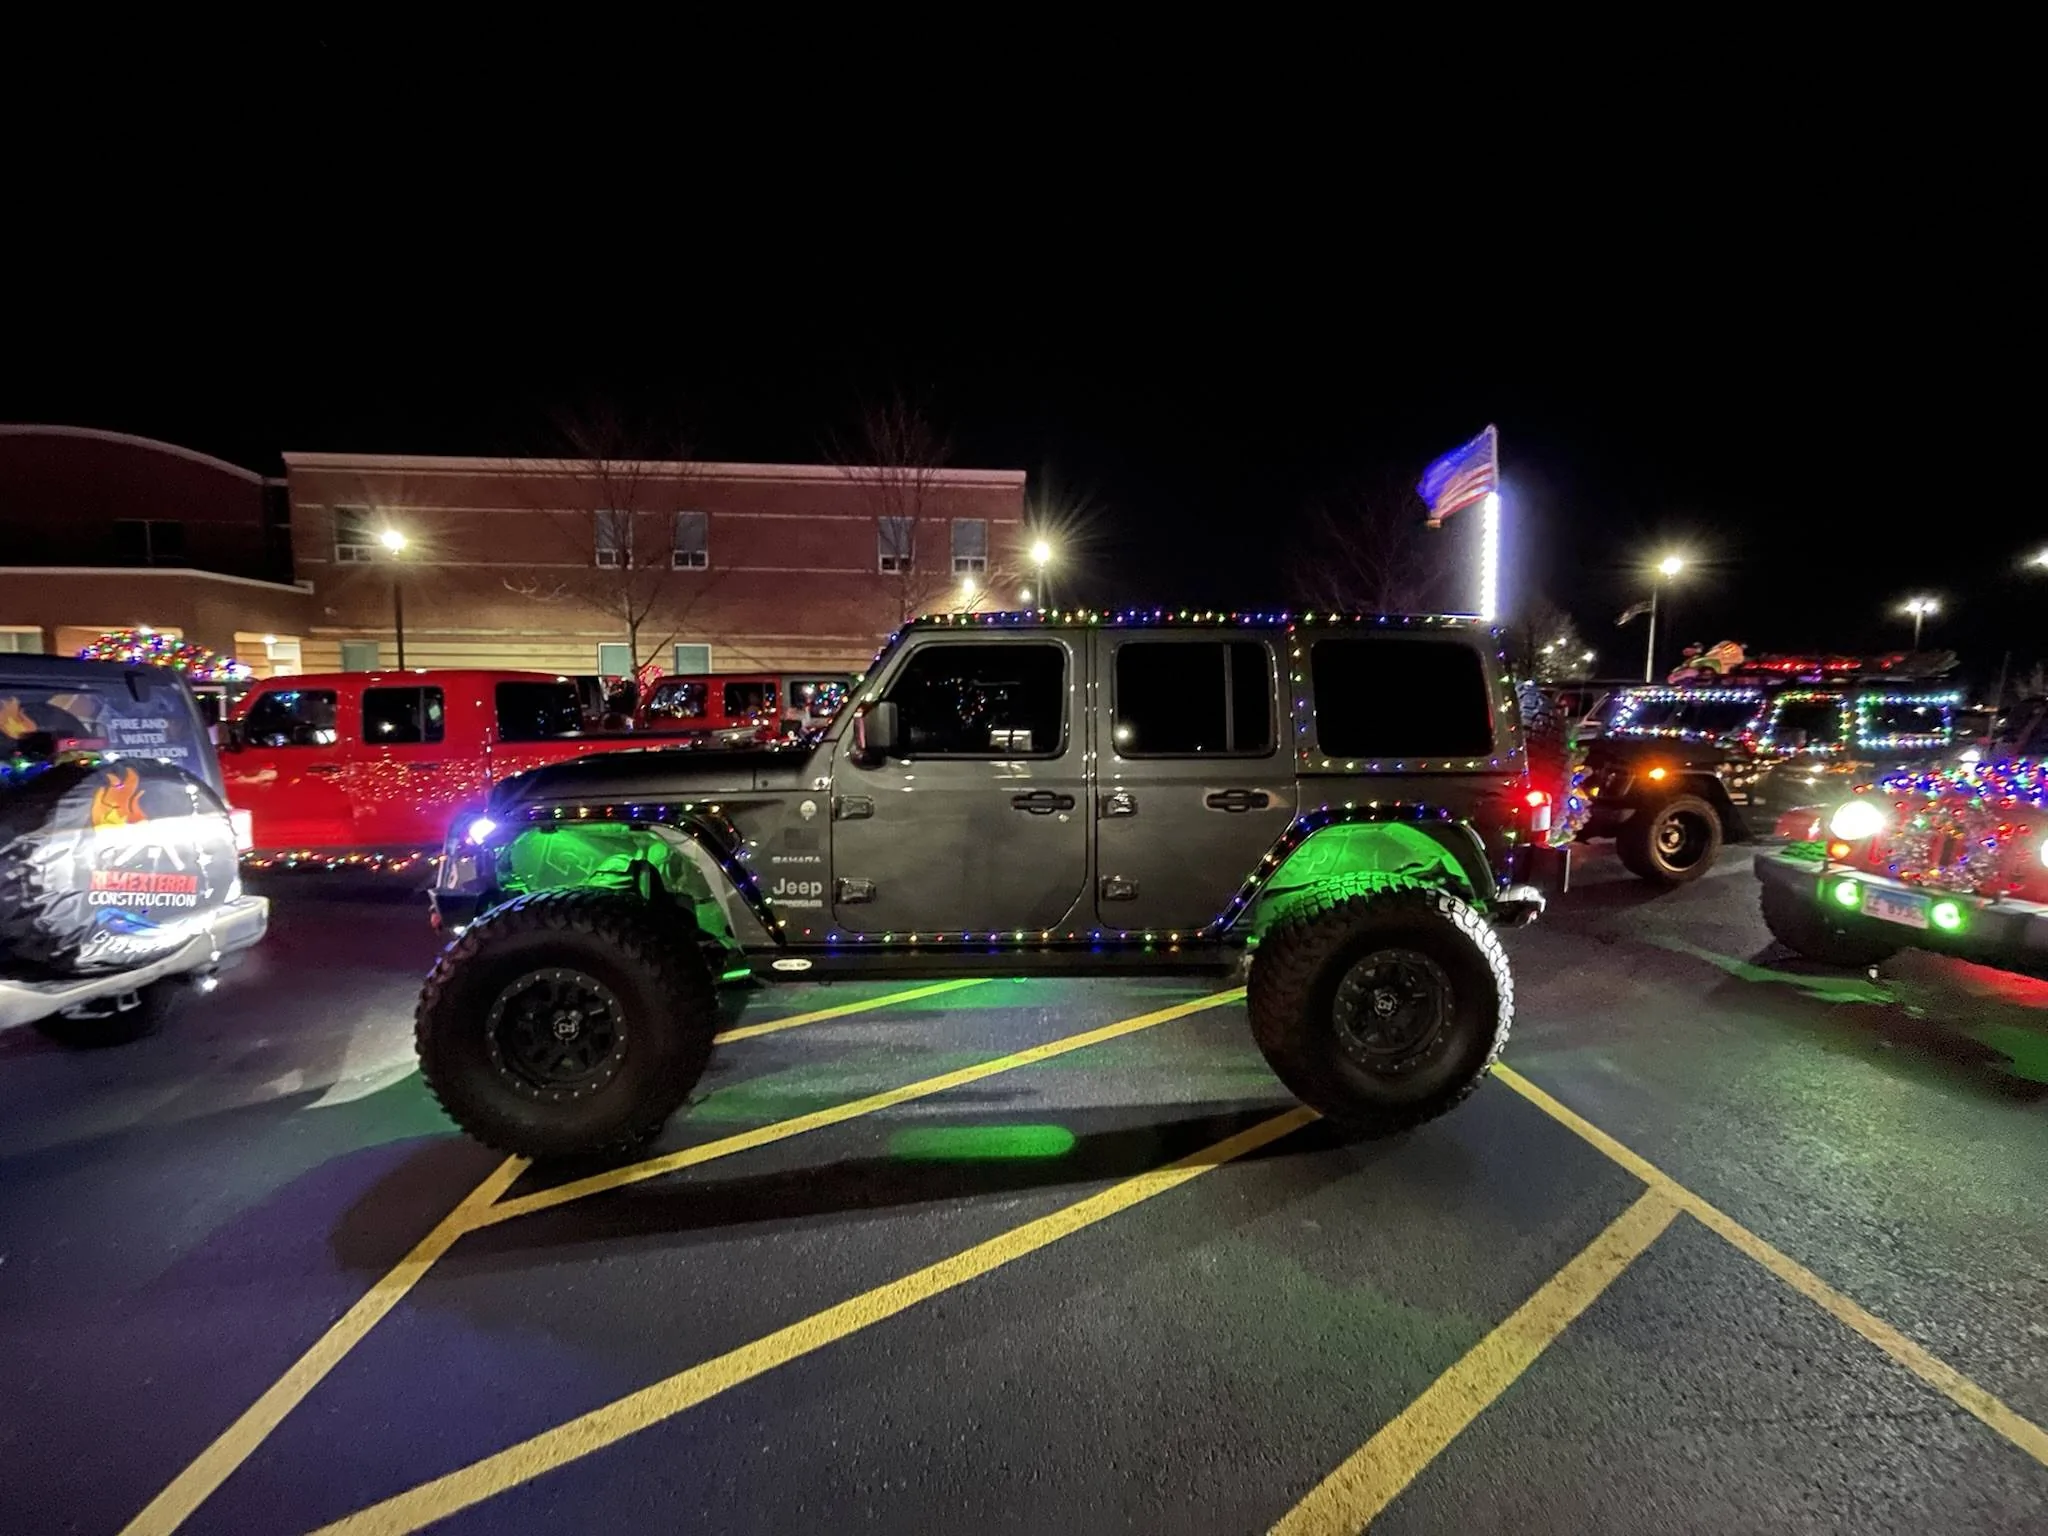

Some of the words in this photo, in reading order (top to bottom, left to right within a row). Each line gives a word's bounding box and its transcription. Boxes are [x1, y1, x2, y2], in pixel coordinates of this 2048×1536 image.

[111, 718, 140, 730] FIRE
[141, 718, 169, 730] AND
[121, 733, 167, 745] WATER
[772, 877, 823, 897] Jeep
[88, 891, 197, 907] CONSTRUCTION
